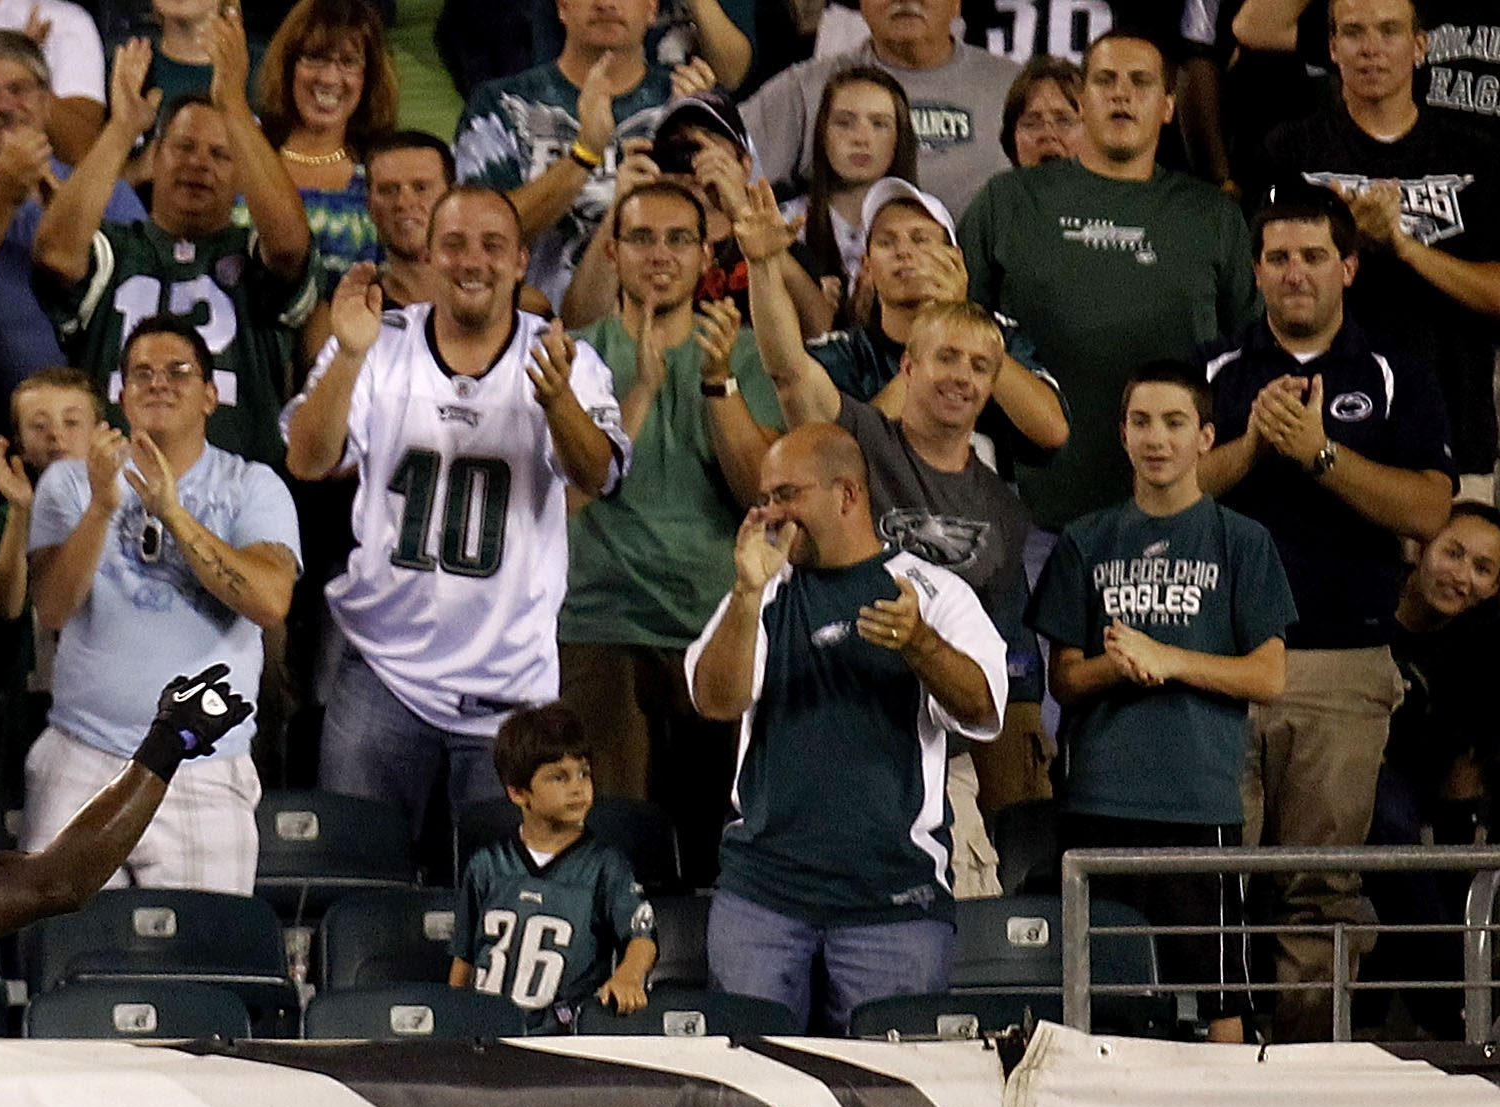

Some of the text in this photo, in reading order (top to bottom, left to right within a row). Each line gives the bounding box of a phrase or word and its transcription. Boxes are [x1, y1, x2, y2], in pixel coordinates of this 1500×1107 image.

[1426, 66, 1500, 117] EAG
[388, 446, 511, 578] 10
[1093, 557, 1220, 592] PHILADELPHIA
[1102, 583, 1203, 616] EAGLES
[474, 908, 573, 1011] 36
